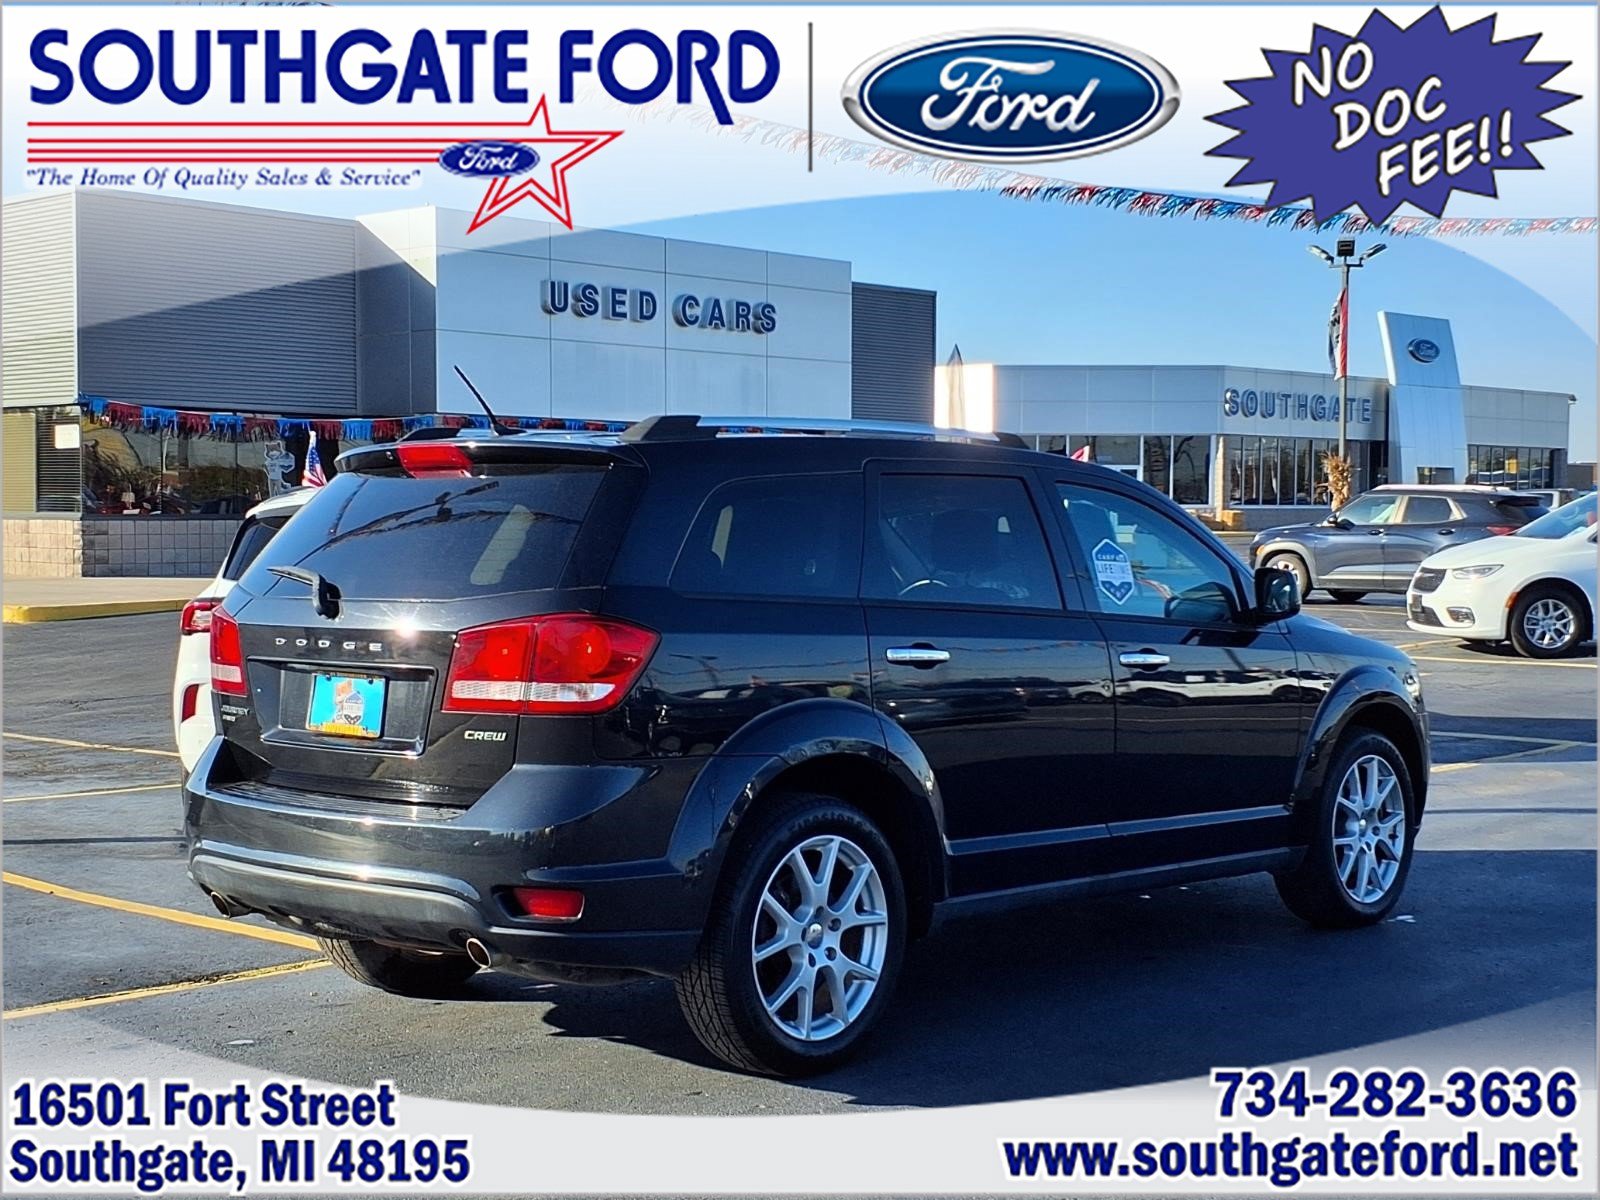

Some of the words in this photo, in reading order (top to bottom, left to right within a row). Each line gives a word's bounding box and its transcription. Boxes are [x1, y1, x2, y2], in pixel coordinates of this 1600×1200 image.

[541, 280, 658, 321] USED
[673, 294, 777, 334] CARS
[1224, 387, 1371, 423] SOUTHGATE
[275, 637, 382, 652] DODGE
[464, 730, 507, 741] CREW
